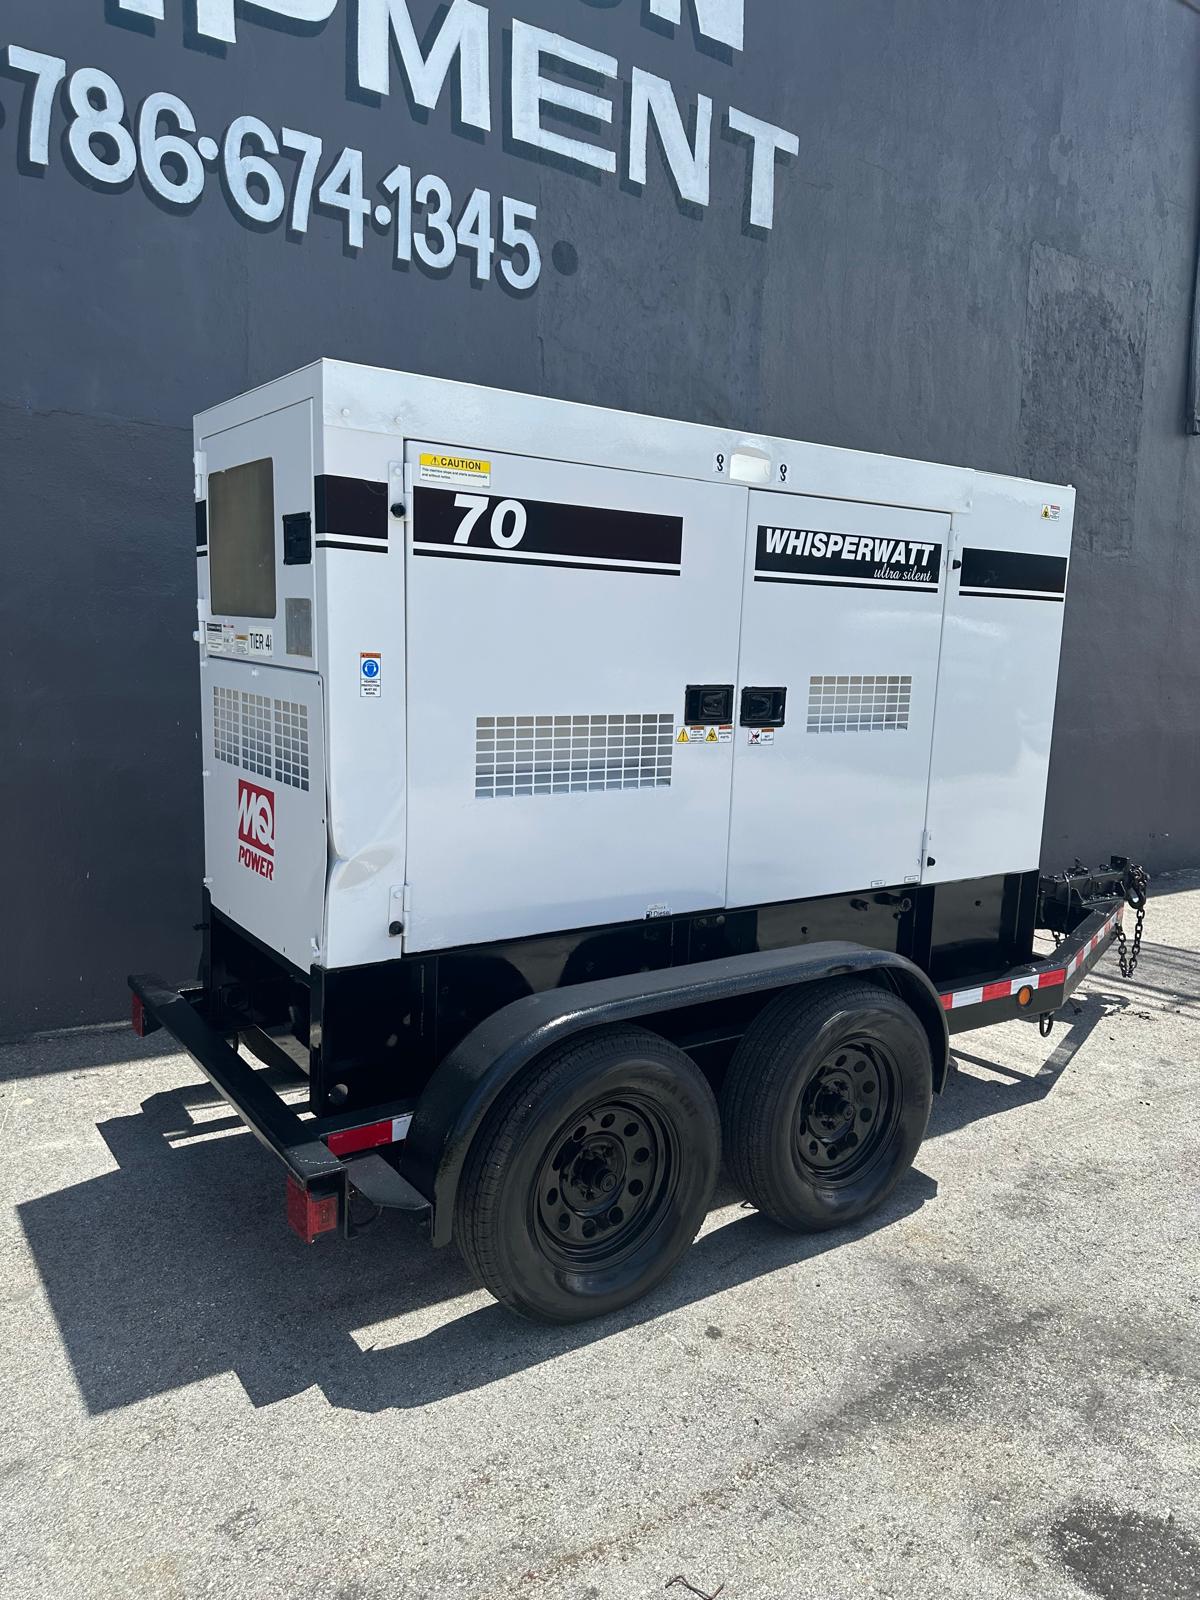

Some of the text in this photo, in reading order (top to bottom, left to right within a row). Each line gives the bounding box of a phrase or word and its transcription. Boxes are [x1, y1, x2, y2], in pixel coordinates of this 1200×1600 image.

[440, 457, 481, 470] CAUTION
[453, 493, 527, 549] 70
[766, 528, 935, 567] WHISPERWATT
[874, 563, 932, 582] ultra silent
[249, 633, 264, 650] TIER
[265, 634, 272, 651] 4i
[238, 845, 275, 881] POWER
